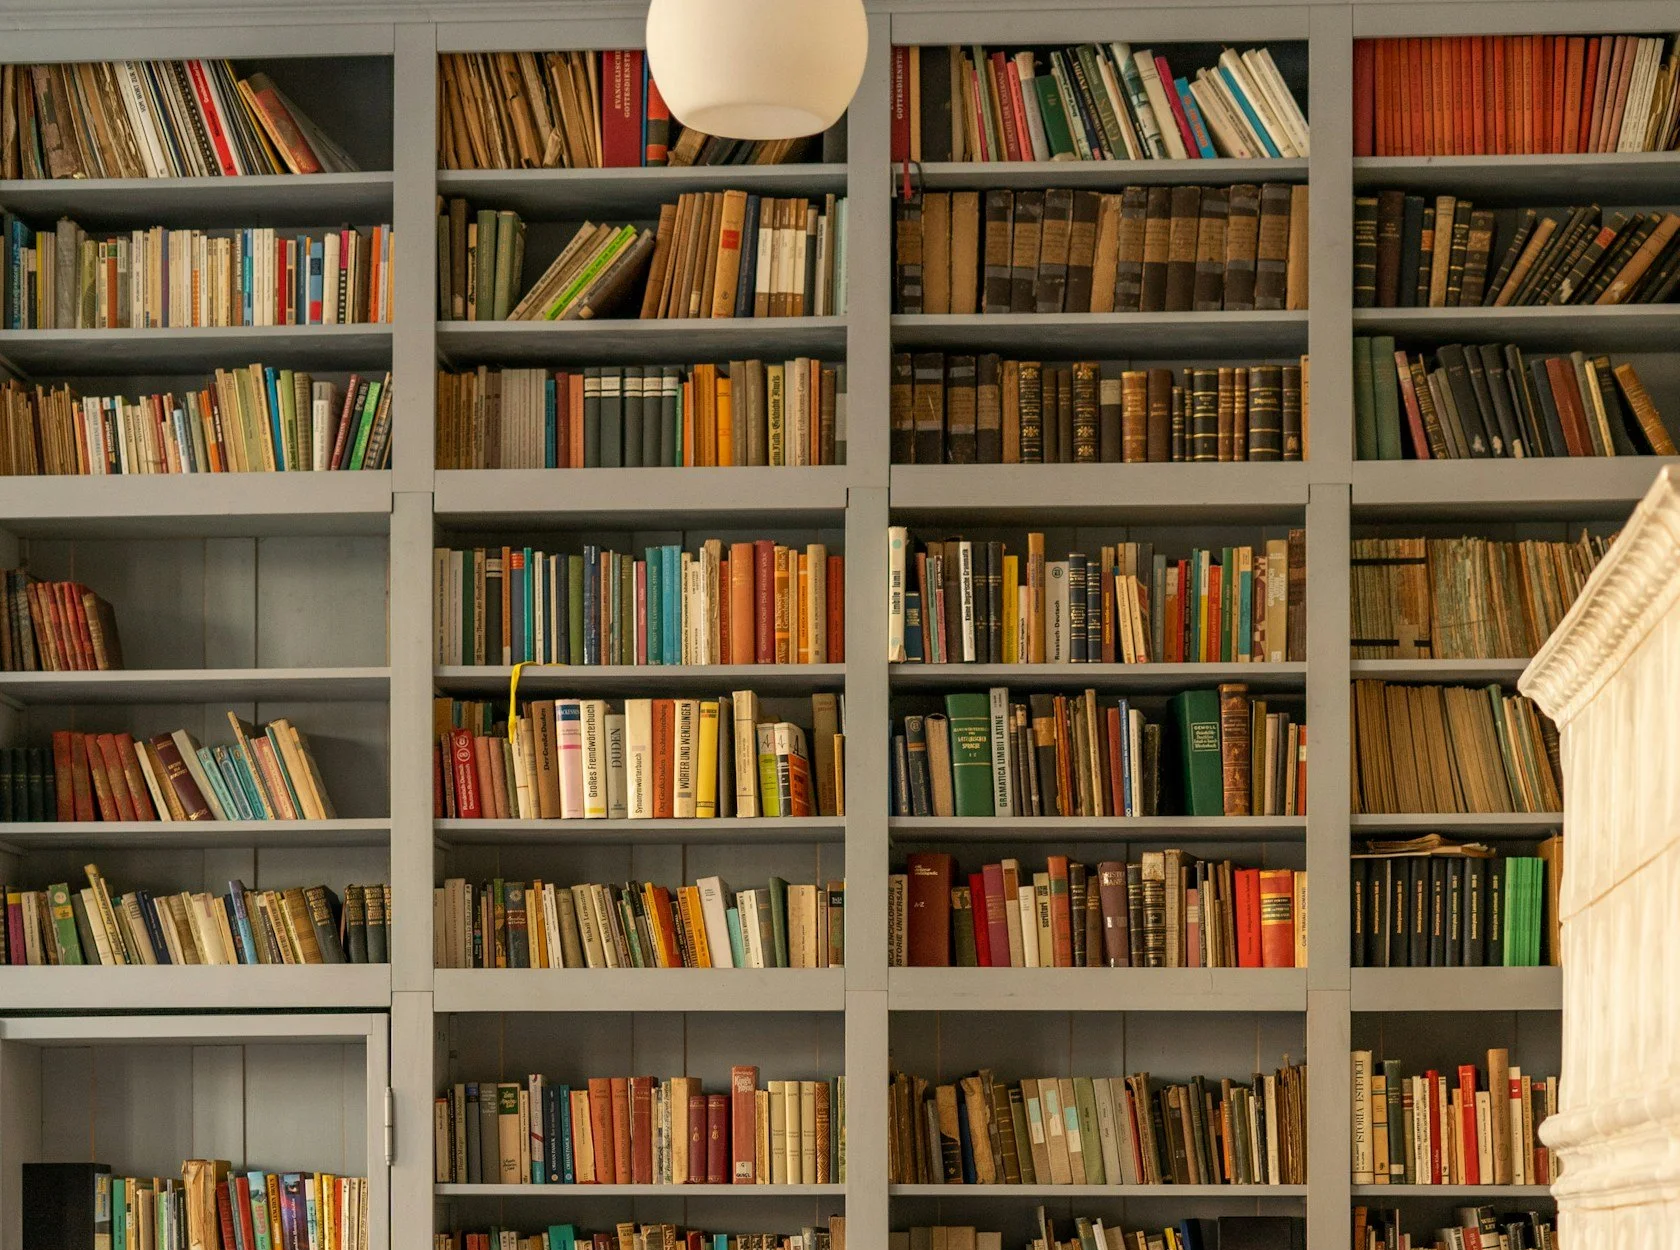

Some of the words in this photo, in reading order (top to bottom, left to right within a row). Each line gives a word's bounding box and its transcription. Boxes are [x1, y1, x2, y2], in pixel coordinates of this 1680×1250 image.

[128, 71, 137, 83] ZUR
[132, 83, 142, 99] WORT
[138, 100, 146, 112] VOM
[961, 548, 969, 576] Grammatik
[891, 570, 900, 587] lumii
[891, 591, 900, 614] limbile
[539, 707, 547, 732] Duden
[659, 703, 667, 755] Rechtschreibung
[679, 702, 691, 744] WENDUNGEN
[995, 714, 1004, 739] LATINE
[585, 703, 597, 769] Fremdwörterbuch
[610, 727, 622, 768] DUDEN
[680, 745, 690, 760] UND
[996, 741, 1005, 764] LIMBII
[658, 758, 666, 778] Duden
[678, 760, 690, 788] WÖRTER
[587, 770, 598, 797] Großes
[633, 752, 643, 813] Synonymwörterbuch
[997, 766, 1007, 807] GRAMATICA
[577, 889, 589, 921] Lermontow
[583, 921, 593, 942] Michail
[601, 921, 611, 943] Michail
[1355, 1107, 1364, 1142] ISTORIA
